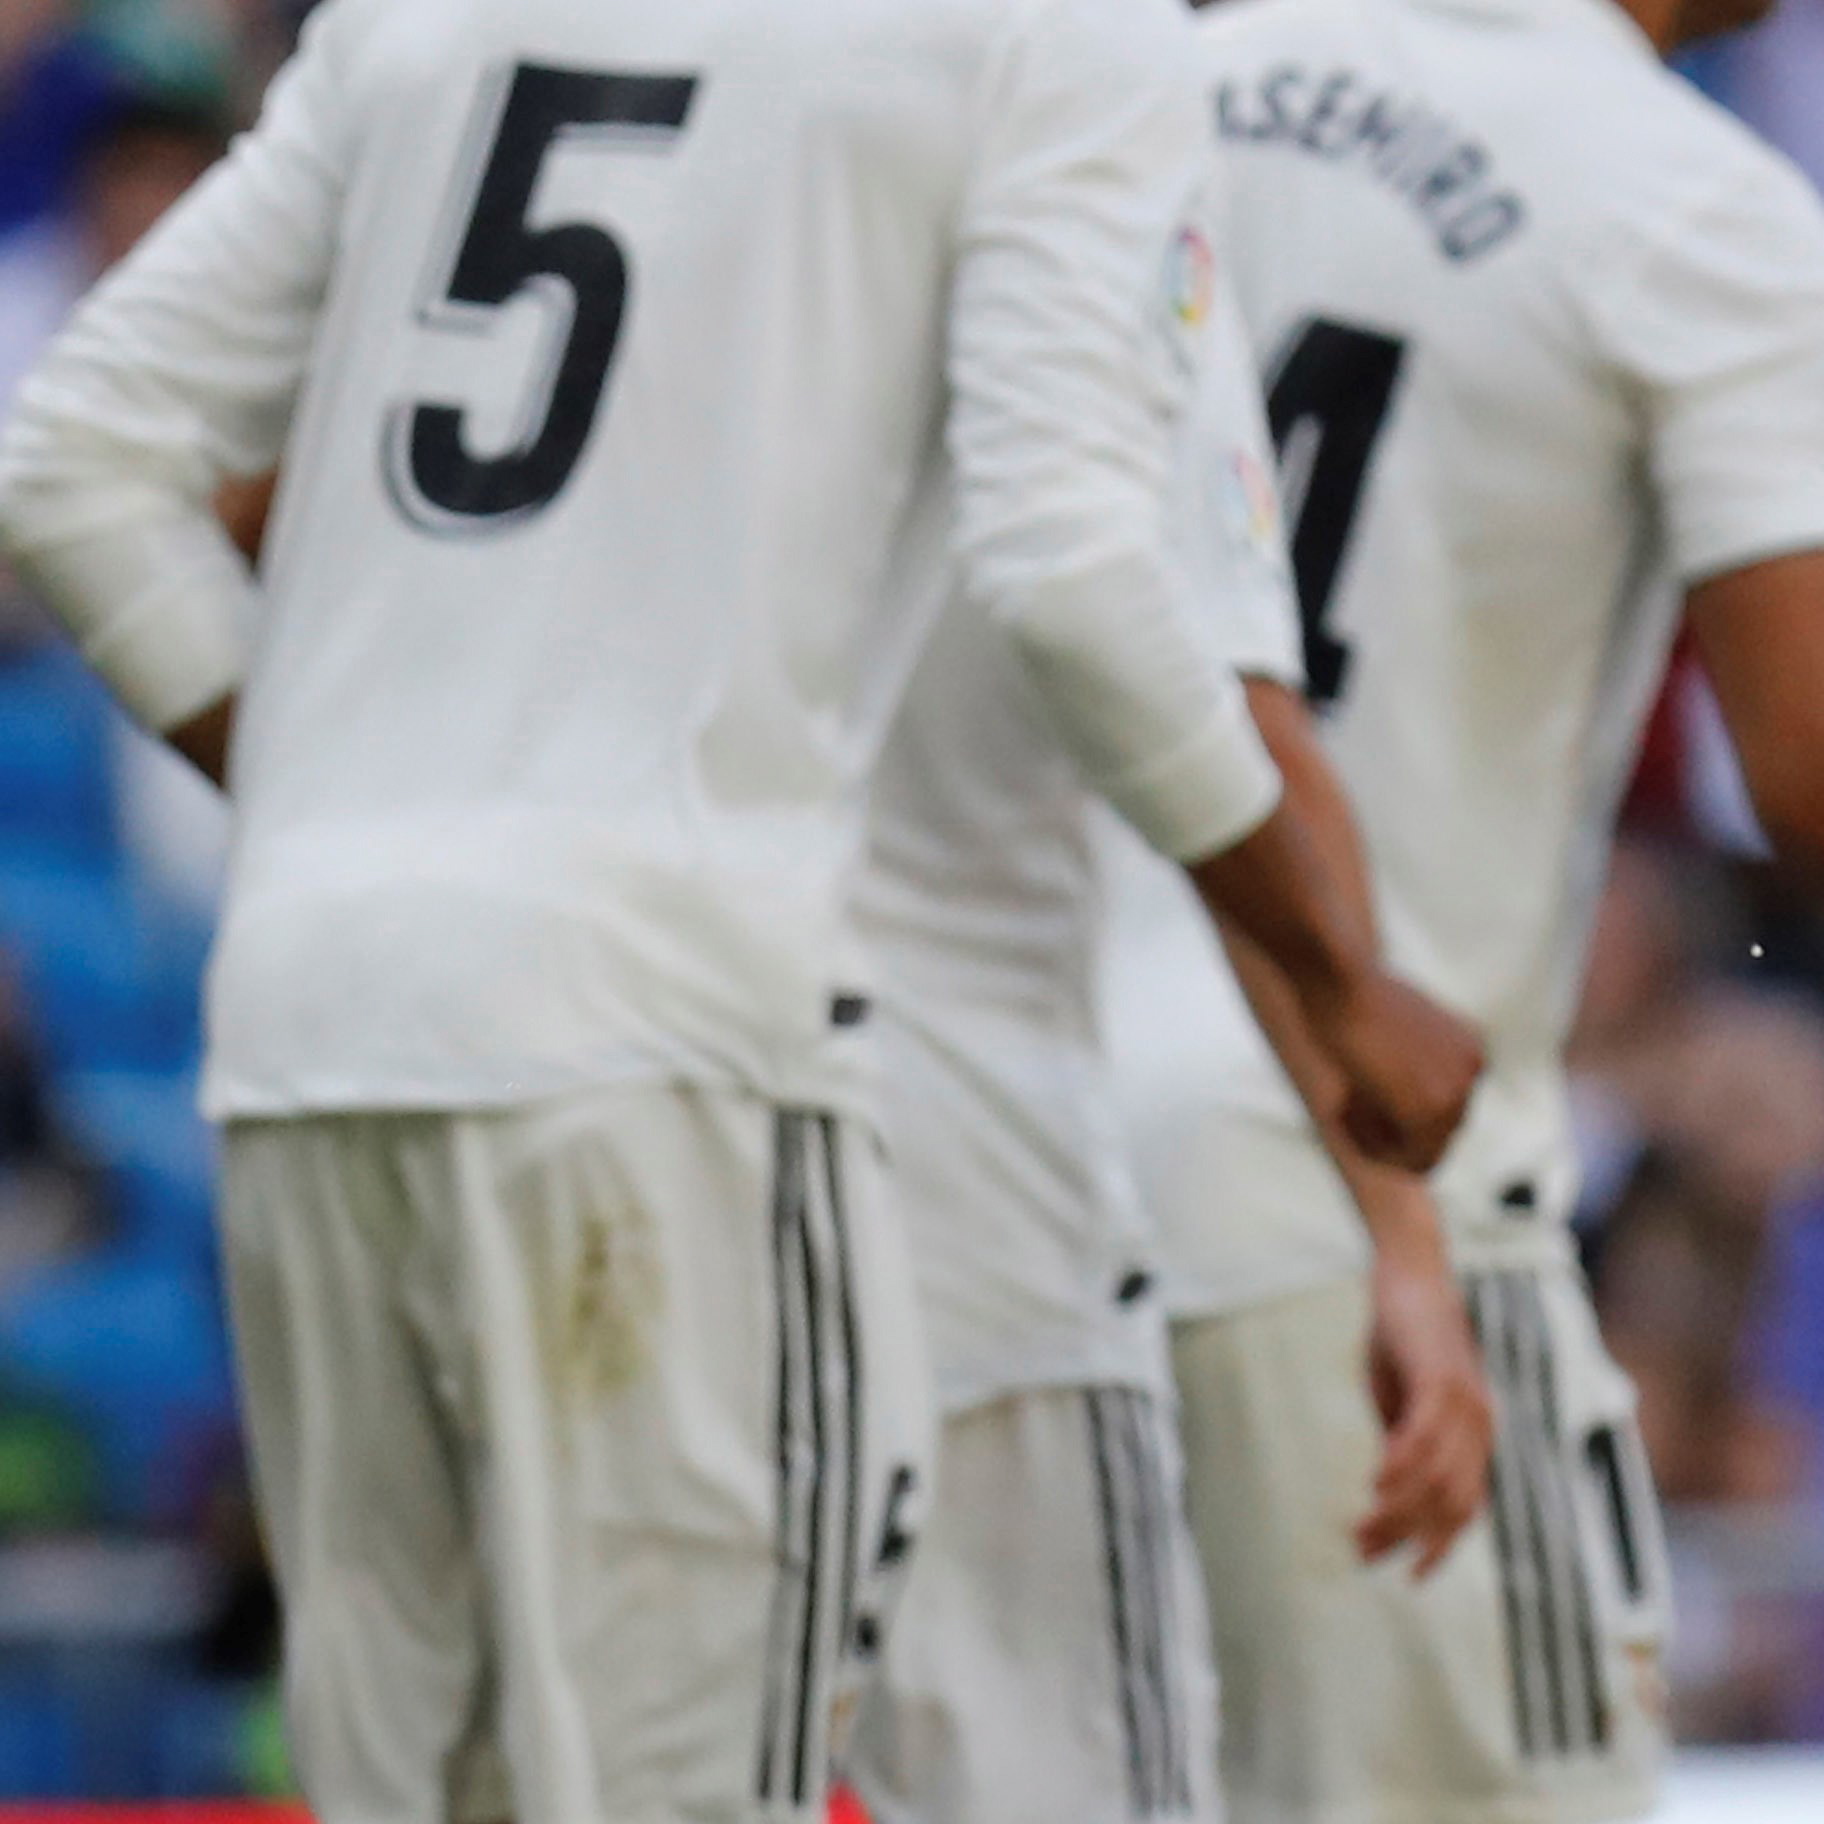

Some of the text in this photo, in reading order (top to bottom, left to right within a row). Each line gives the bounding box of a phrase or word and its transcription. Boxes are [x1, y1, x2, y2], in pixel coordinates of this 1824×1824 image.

[386, 62, 702, 530] 5
[1212, 62, 1530, 268] SEMIRO
[1267, 316, 1408, 706] 4
